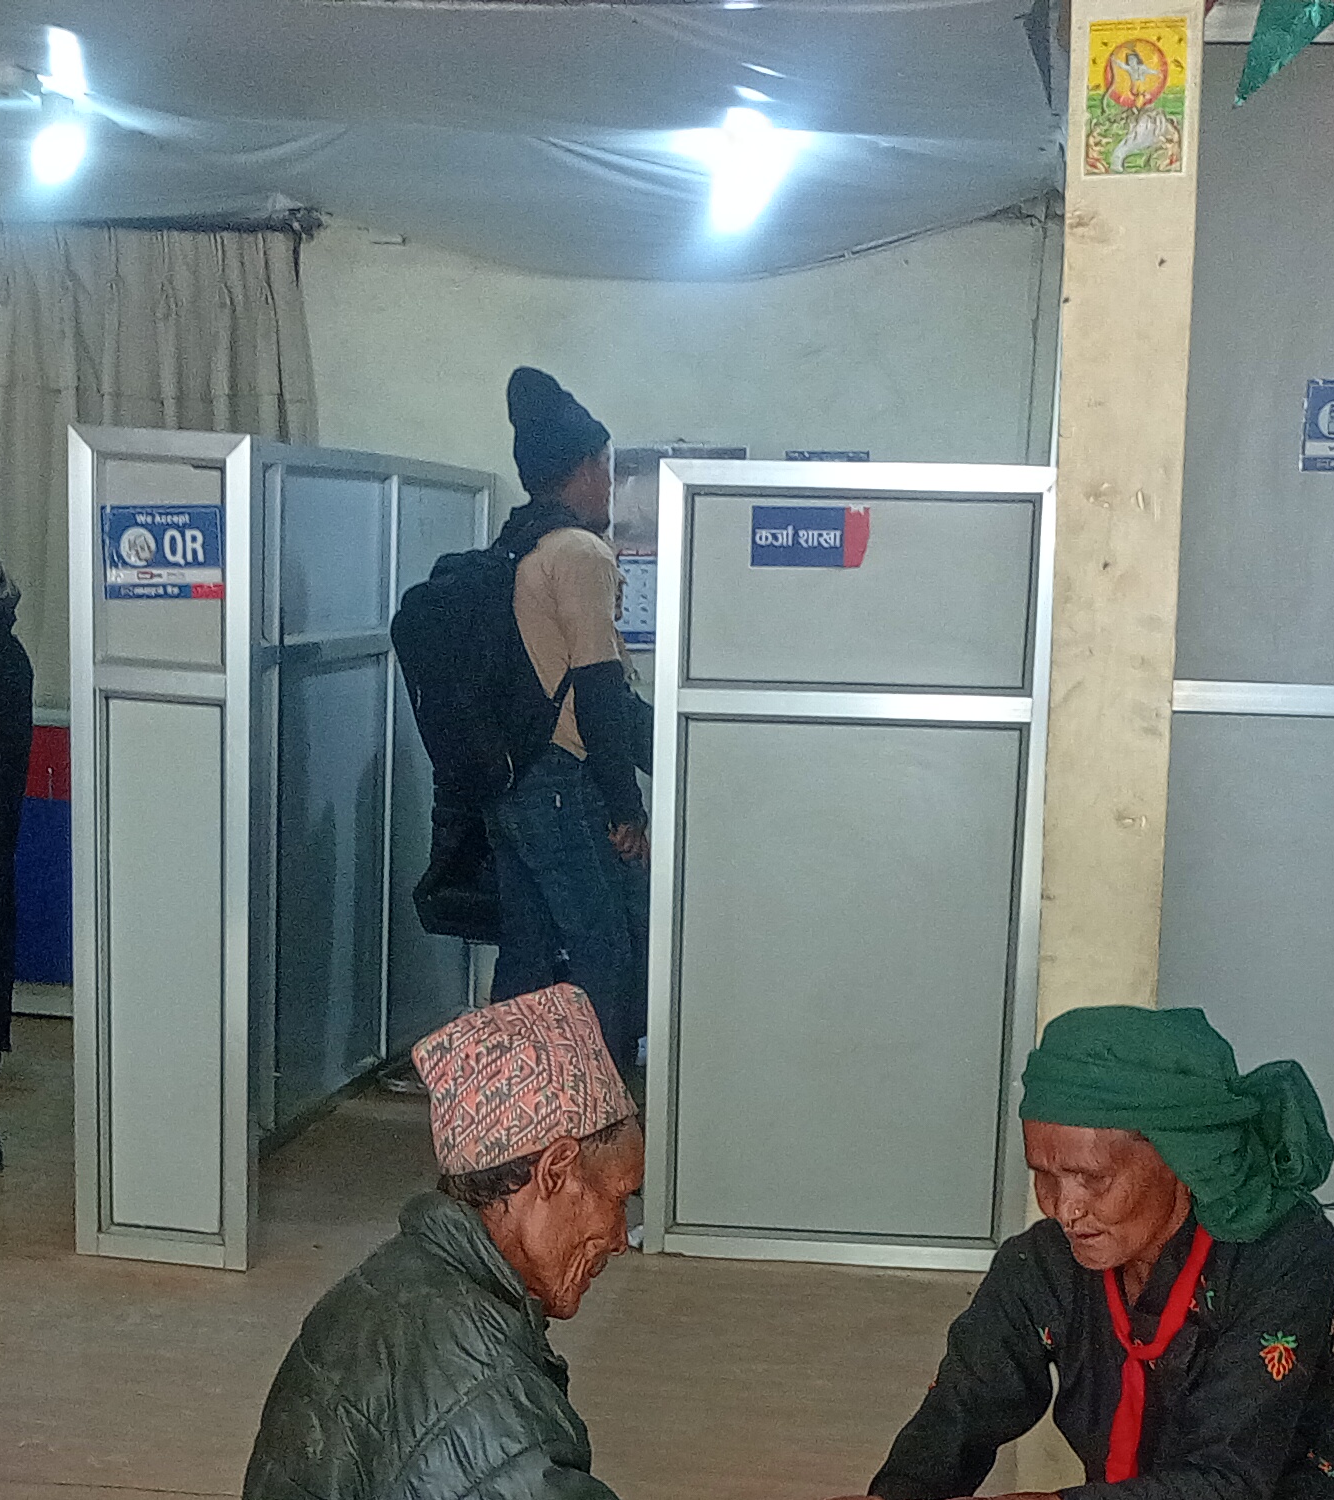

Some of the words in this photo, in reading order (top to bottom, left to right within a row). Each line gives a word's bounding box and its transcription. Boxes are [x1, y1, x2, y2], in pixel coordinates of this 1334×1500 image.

[162, 527, 206, 567] QR
[755, 525, 794, 547] कर्जा
[798, 529, 843, 548] शाखा
